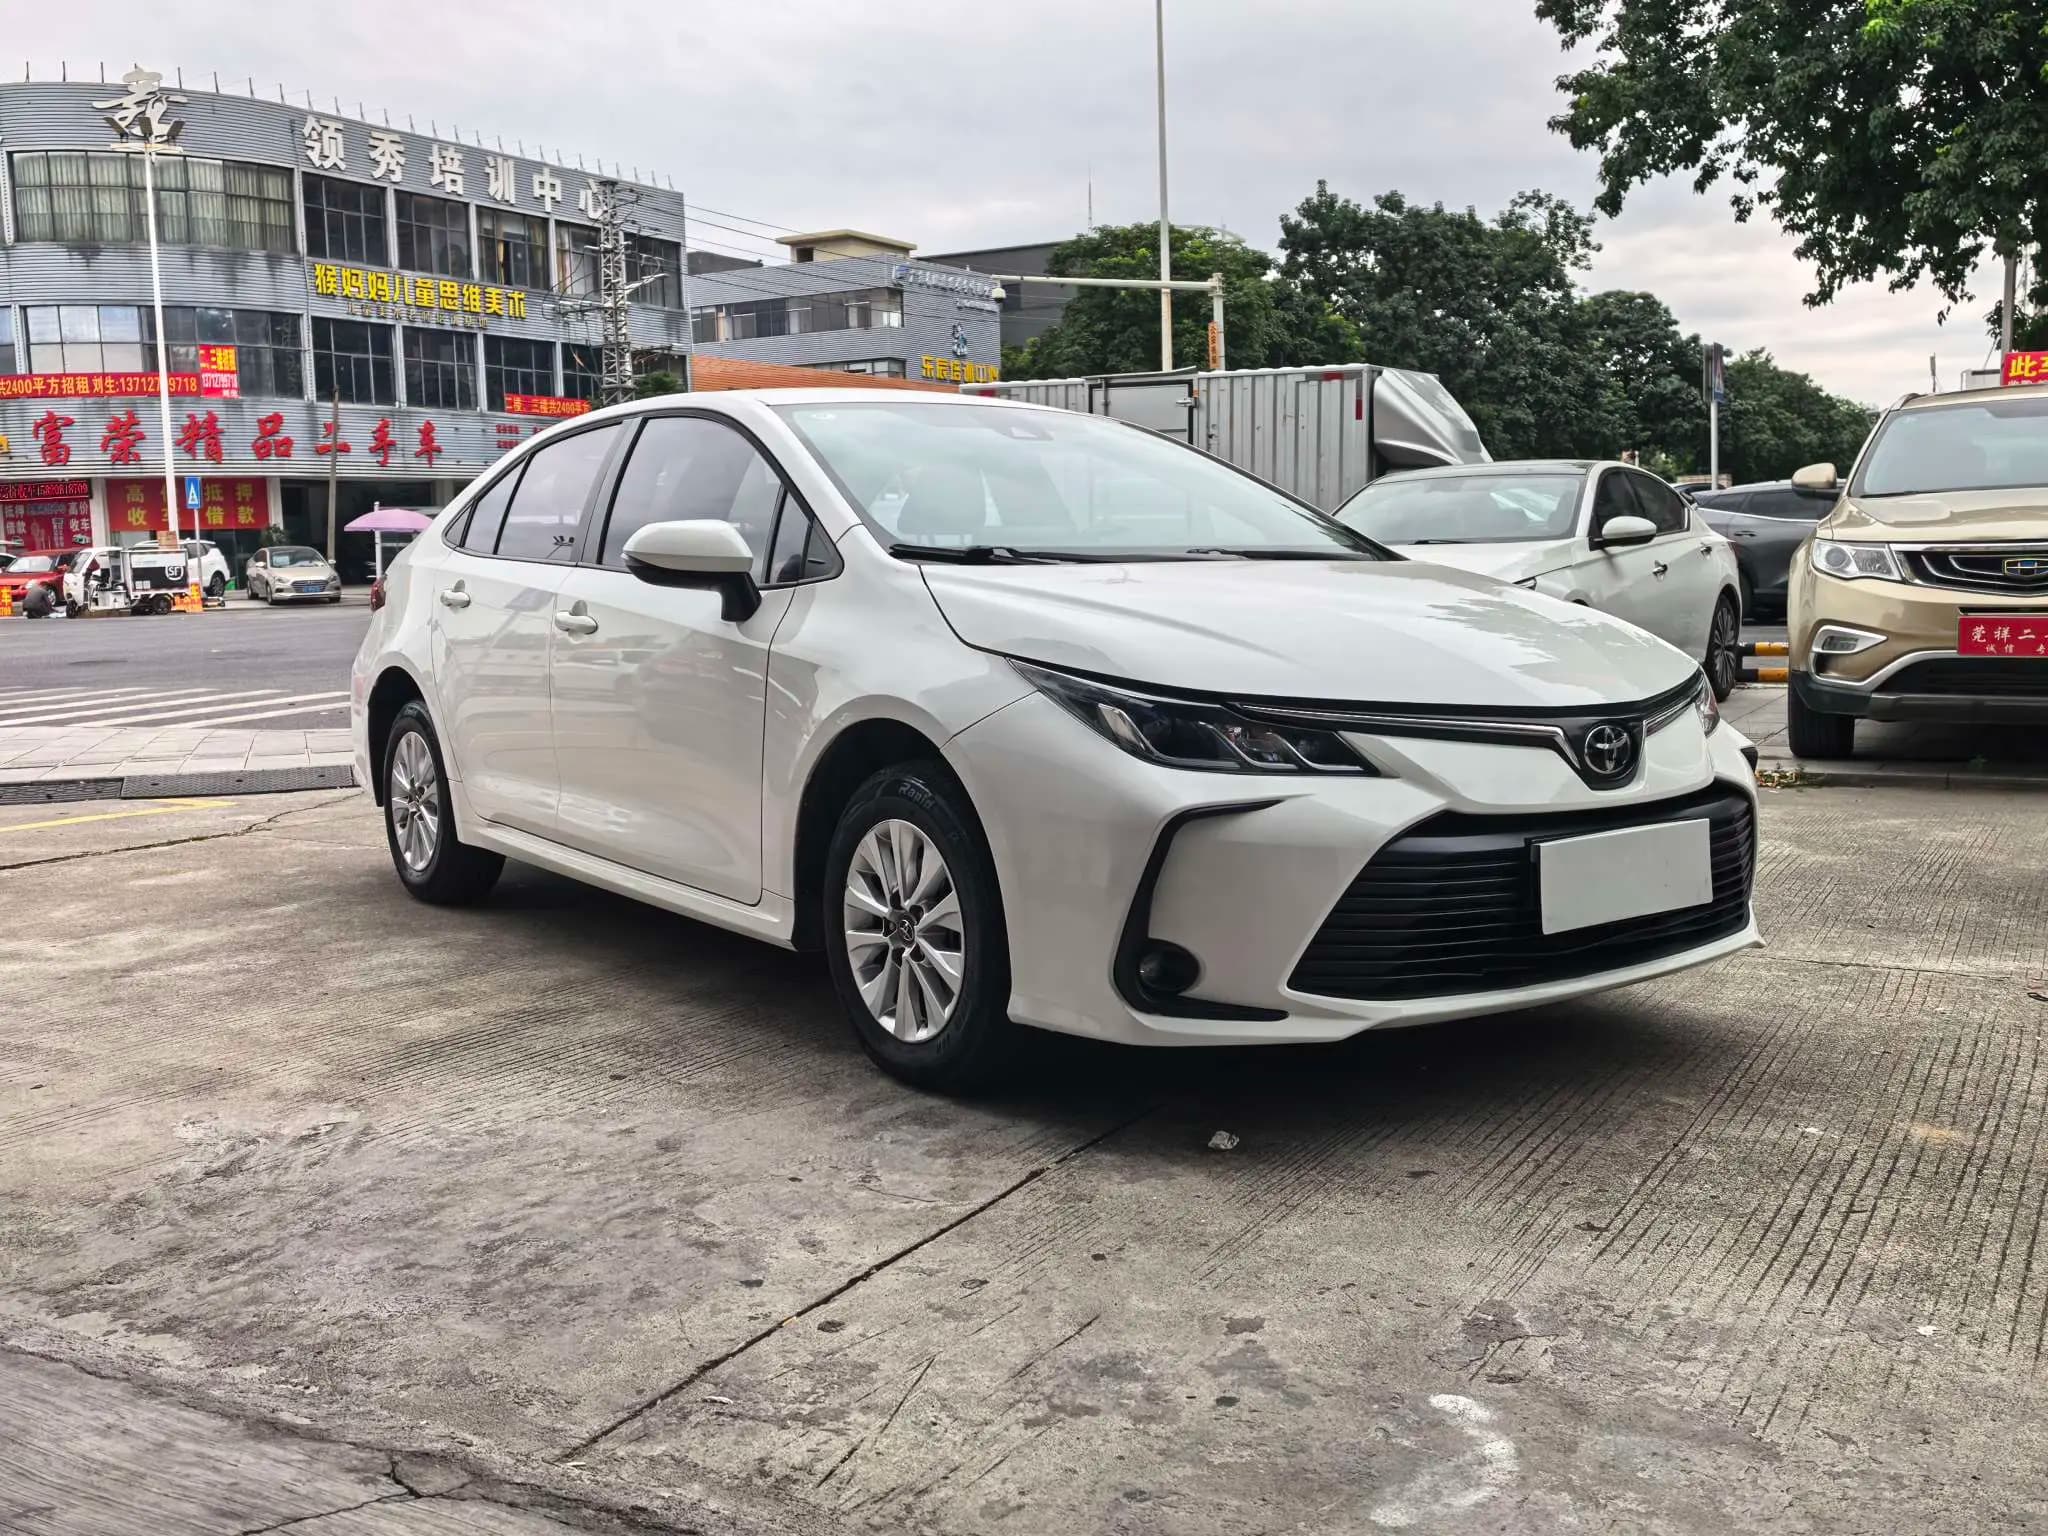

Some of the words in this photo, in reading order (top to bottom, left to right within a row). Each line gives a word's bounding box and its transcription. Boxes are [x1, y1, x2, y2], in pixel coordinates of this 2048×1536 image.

[302, 115, 608, 220] 领秀培训中心
[314, 263, 527, 319] 猴妈妈儿童思维美术
[93, 375, 197, 394] 刘生:1371279718
[33, 409, 442, 468] 富荣精品二手车
[205, 483, 254, 502] 抵押
[206, 506, 255, 525] 借款
[168, 566, 180, 577] SF
[1971, 624, 2048, 643] 莞祥二
